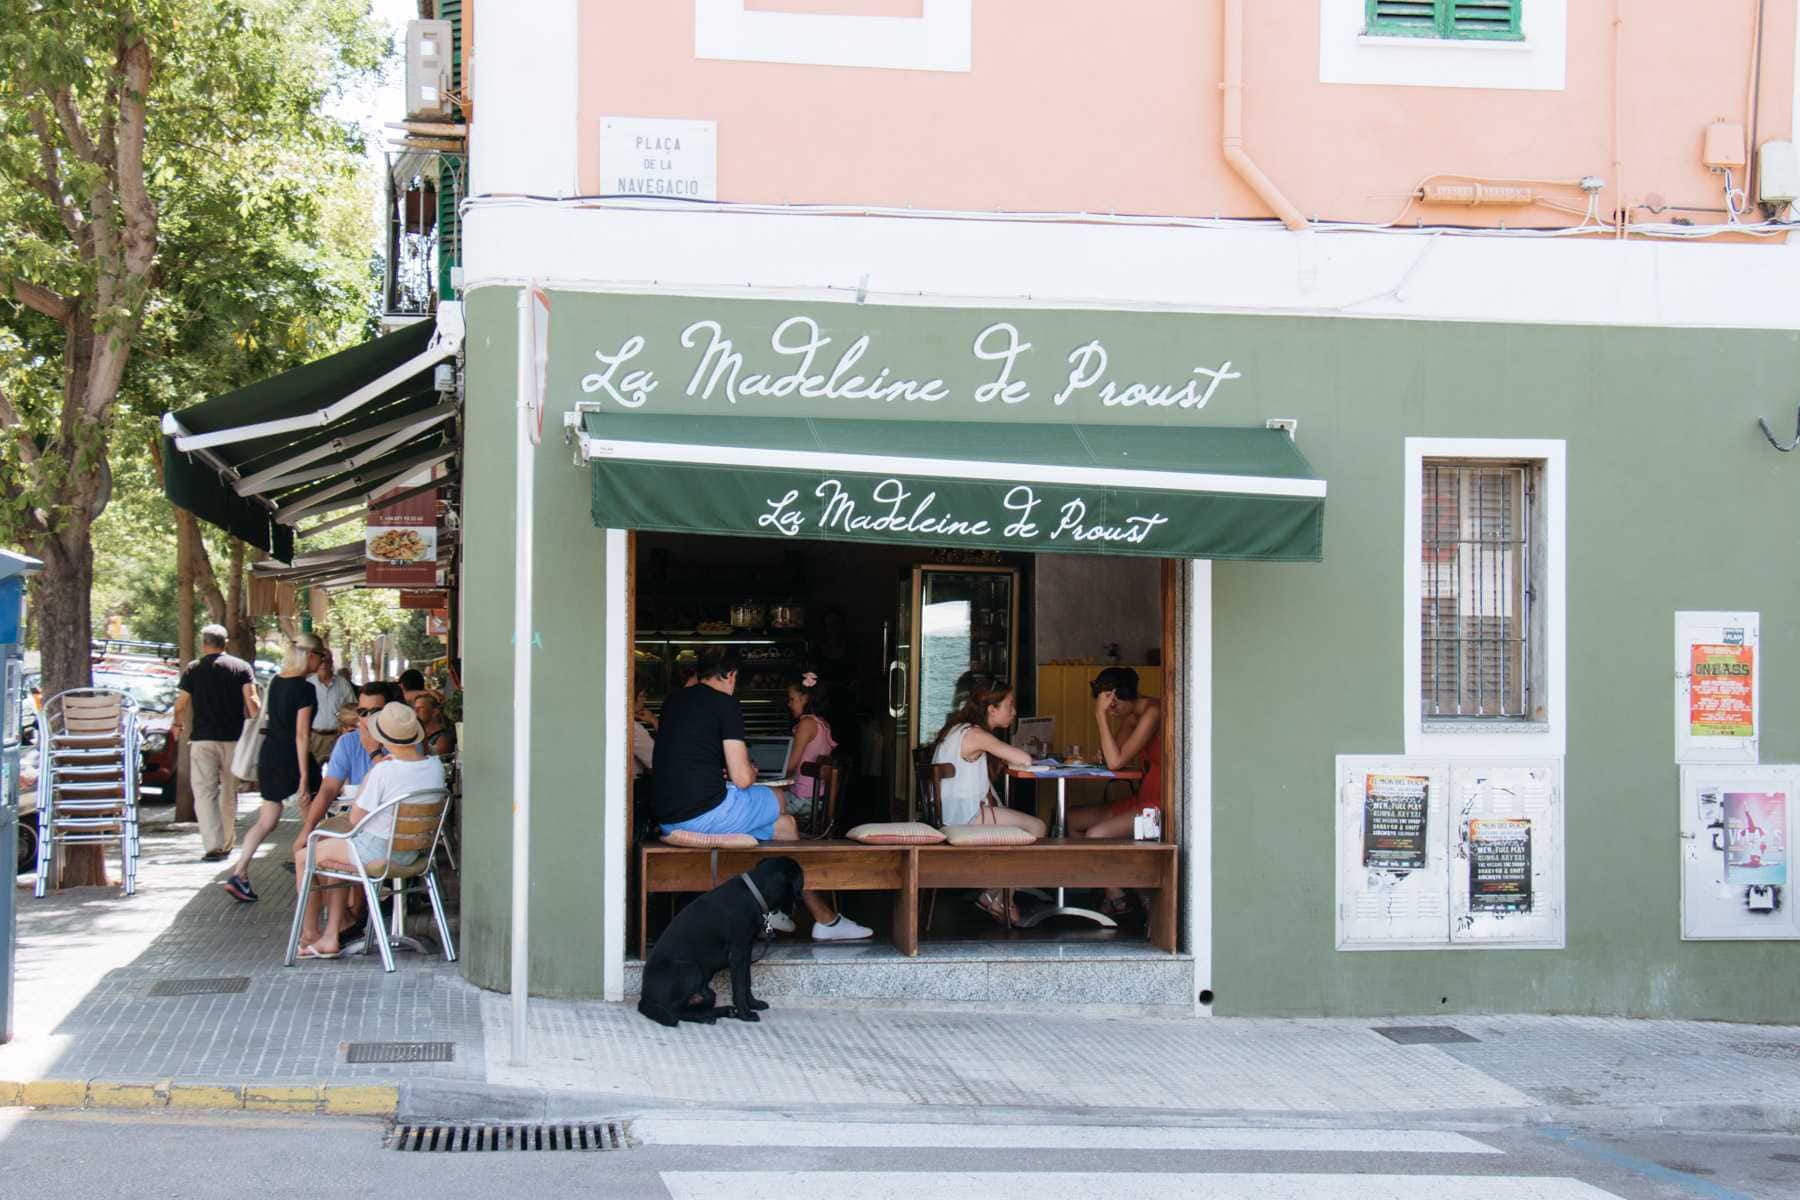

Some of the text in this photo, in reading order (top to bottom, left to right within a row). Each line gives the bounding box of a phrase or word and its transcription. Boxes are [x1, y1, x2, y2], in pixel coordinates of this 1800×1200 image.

[635, 135, 681, 155] PLAÇA
[643, 158, 673, 170] DE LA
[617, 175, 699, 196] NAVEGACIÓ
[581, 315, 1242, 409] La Madeleine de Proust
[758, 479, 1169, 544] La Madeleine de Proust
